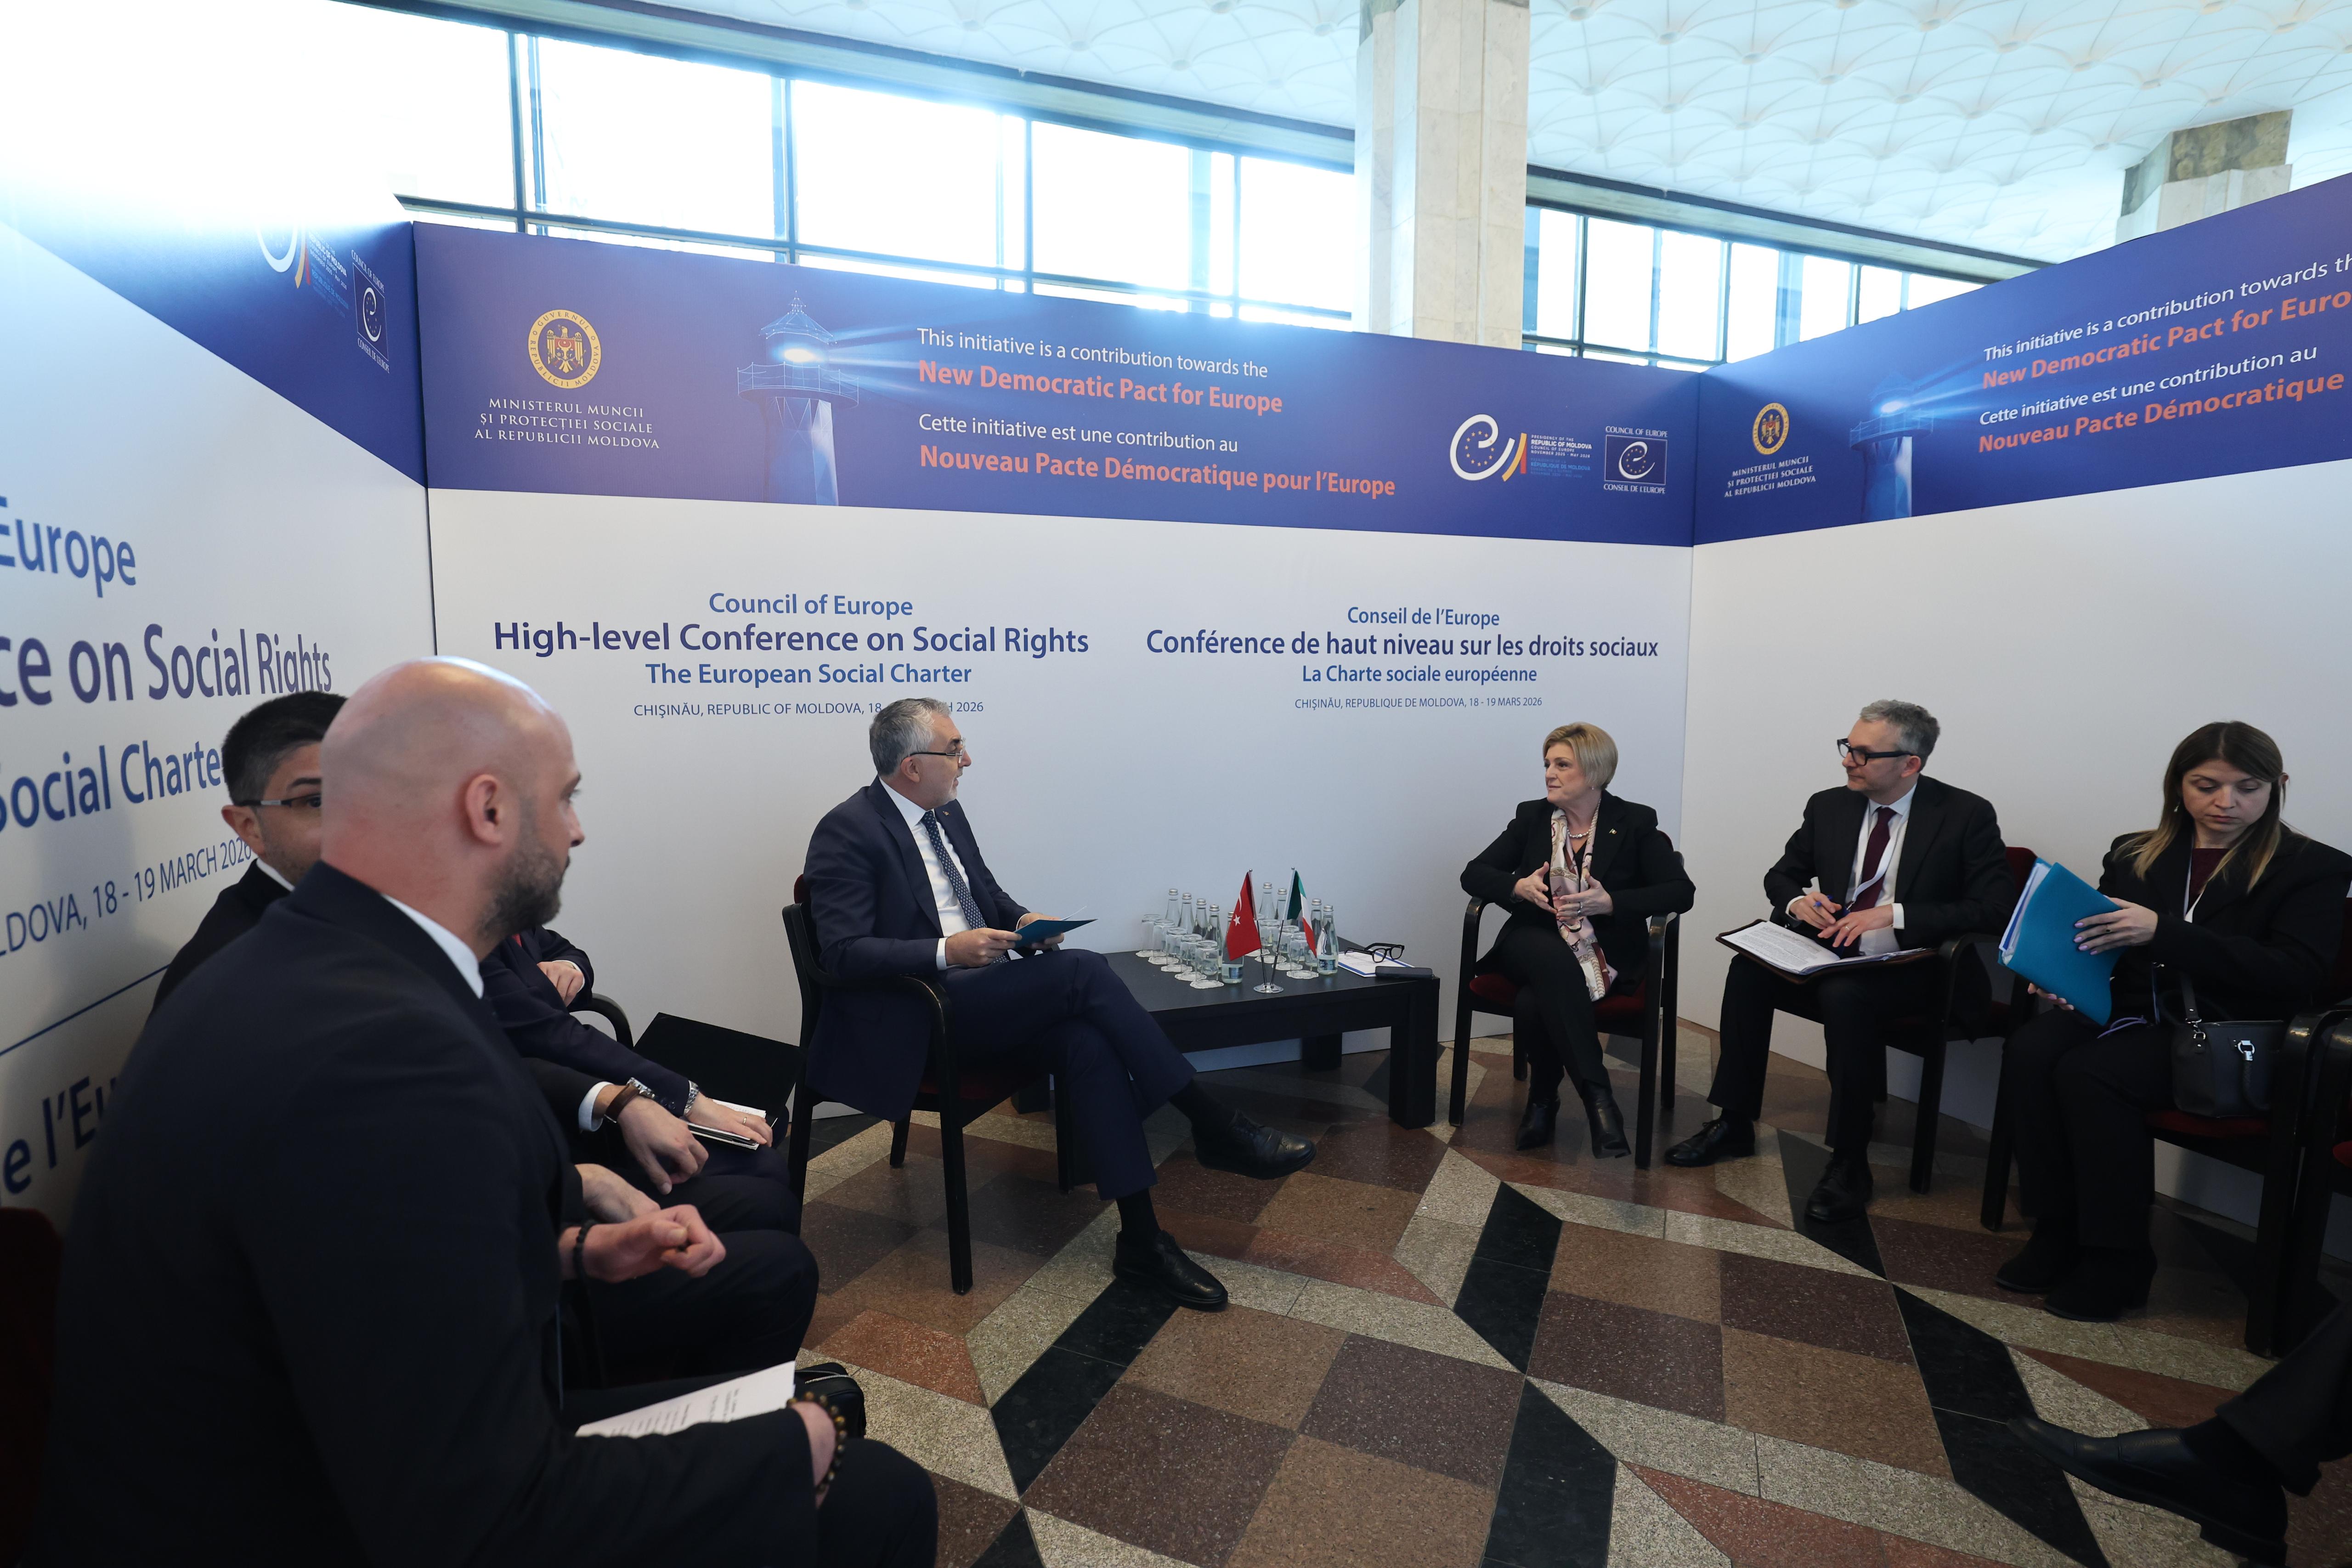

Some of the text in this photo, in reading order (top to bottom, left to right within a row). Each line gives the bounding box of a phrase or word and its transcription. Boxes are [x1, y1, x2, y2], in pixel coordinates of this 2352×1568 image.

[351, 249, 384, 293] COUNCIL OF EUROPE
[537, 311, 589, 331] GUVERNUL
[1984, 344, 2012, 361] This
[2016, 328, 2082, 353] initiative
[2087, 322, 2099, 335] is
[2103, 321, 2112, 331] a
[2117, 289, 2233, 327] contribution
[2240, 262, 2327, 296] towards
[358, 338, 390, 374] CONSEIL DE L’EUROPE
[530, 340, 599, 387] REPUBLICII MOLDOVA
[917, 328, 1267, 377] This initiative is a contribution towards the
[1983, 368, 2026, 388] New
[2030, 334, 2161, 378] Democratic
[2168, 318, 2224, 347] Pact
[2232, 309, 2273, 331] for
[918, 360, 1283, 416] New Democratic Pact for Europe
[1980, 347, 2317, 425] Cette initiative est une contribution au
[490, 399, 642, 417] MINISTERUL MUNCII
[1979, 373, 2344, 452] Nouveau Pacte Démocratique
[475, 429, 659, 448] AL REPUBLICII MOLDOVA
[501, 415, 587, 430] PROTECȚIEI
[594, 420, 652, 433] SOCIALE
[920, 414, 1237, 452] Cette initiative est une contribution au
[1606, 426, 1634, 434] COUNCIL
[921, 445, 1395, 499] Nouveau Pacte Démocratique pour l’Europe
[1732, 456, 1809, 476] MINISTERUL MUNCII
[1781, 465, 1813, 477] SOCIALE
[1735, 483, 1775, 496] REPUBLICII
[1777, 476, 1815, 488] MOLDOVA
[710, 593, 912, 620] Council of Europe
[1348, 607, 1499, 629] Conseil de l’Europe
[495, 622, 1088, 658] High-level Conference on Social Rights
[1147, 629, 1658, 656] Conférence de haut niveau sur les droits sociaux
[69, 639, 133, 703] on
[144, 623, 251, 701] Social
[257, 633, 332, 694] Rights
[645, 663, 971, 688] The European Social Charter
[1303, 665, 1537, 685] La Charte sociale européenne
[708, 704, 770, 714] REPUBLIC
[775, 704, 791, 714] OF
[796, 703, 864, 714] MOLDOVA,
[869, 703, 882, 713] 18
[957, 702, 983, 712] 2026
[1346, 698, 1402, 708] REPUBLIQUE
[1406, 698, 1416, 707] DE
[1419, 698, 1466, 708] MOLDOVA,
[1470, 698, 1478, 707] 18
[1498, 697, 1521, 706] MARS
[1523, 697, 1542, 706] 2026
[120, 740, 226, 804] Charte
[93, 881, 117, 919] 18
[134, 870, 155, 902] 19
[160, 847, 217, 894] MARCH
[220, 836, 252, 870] 2026
